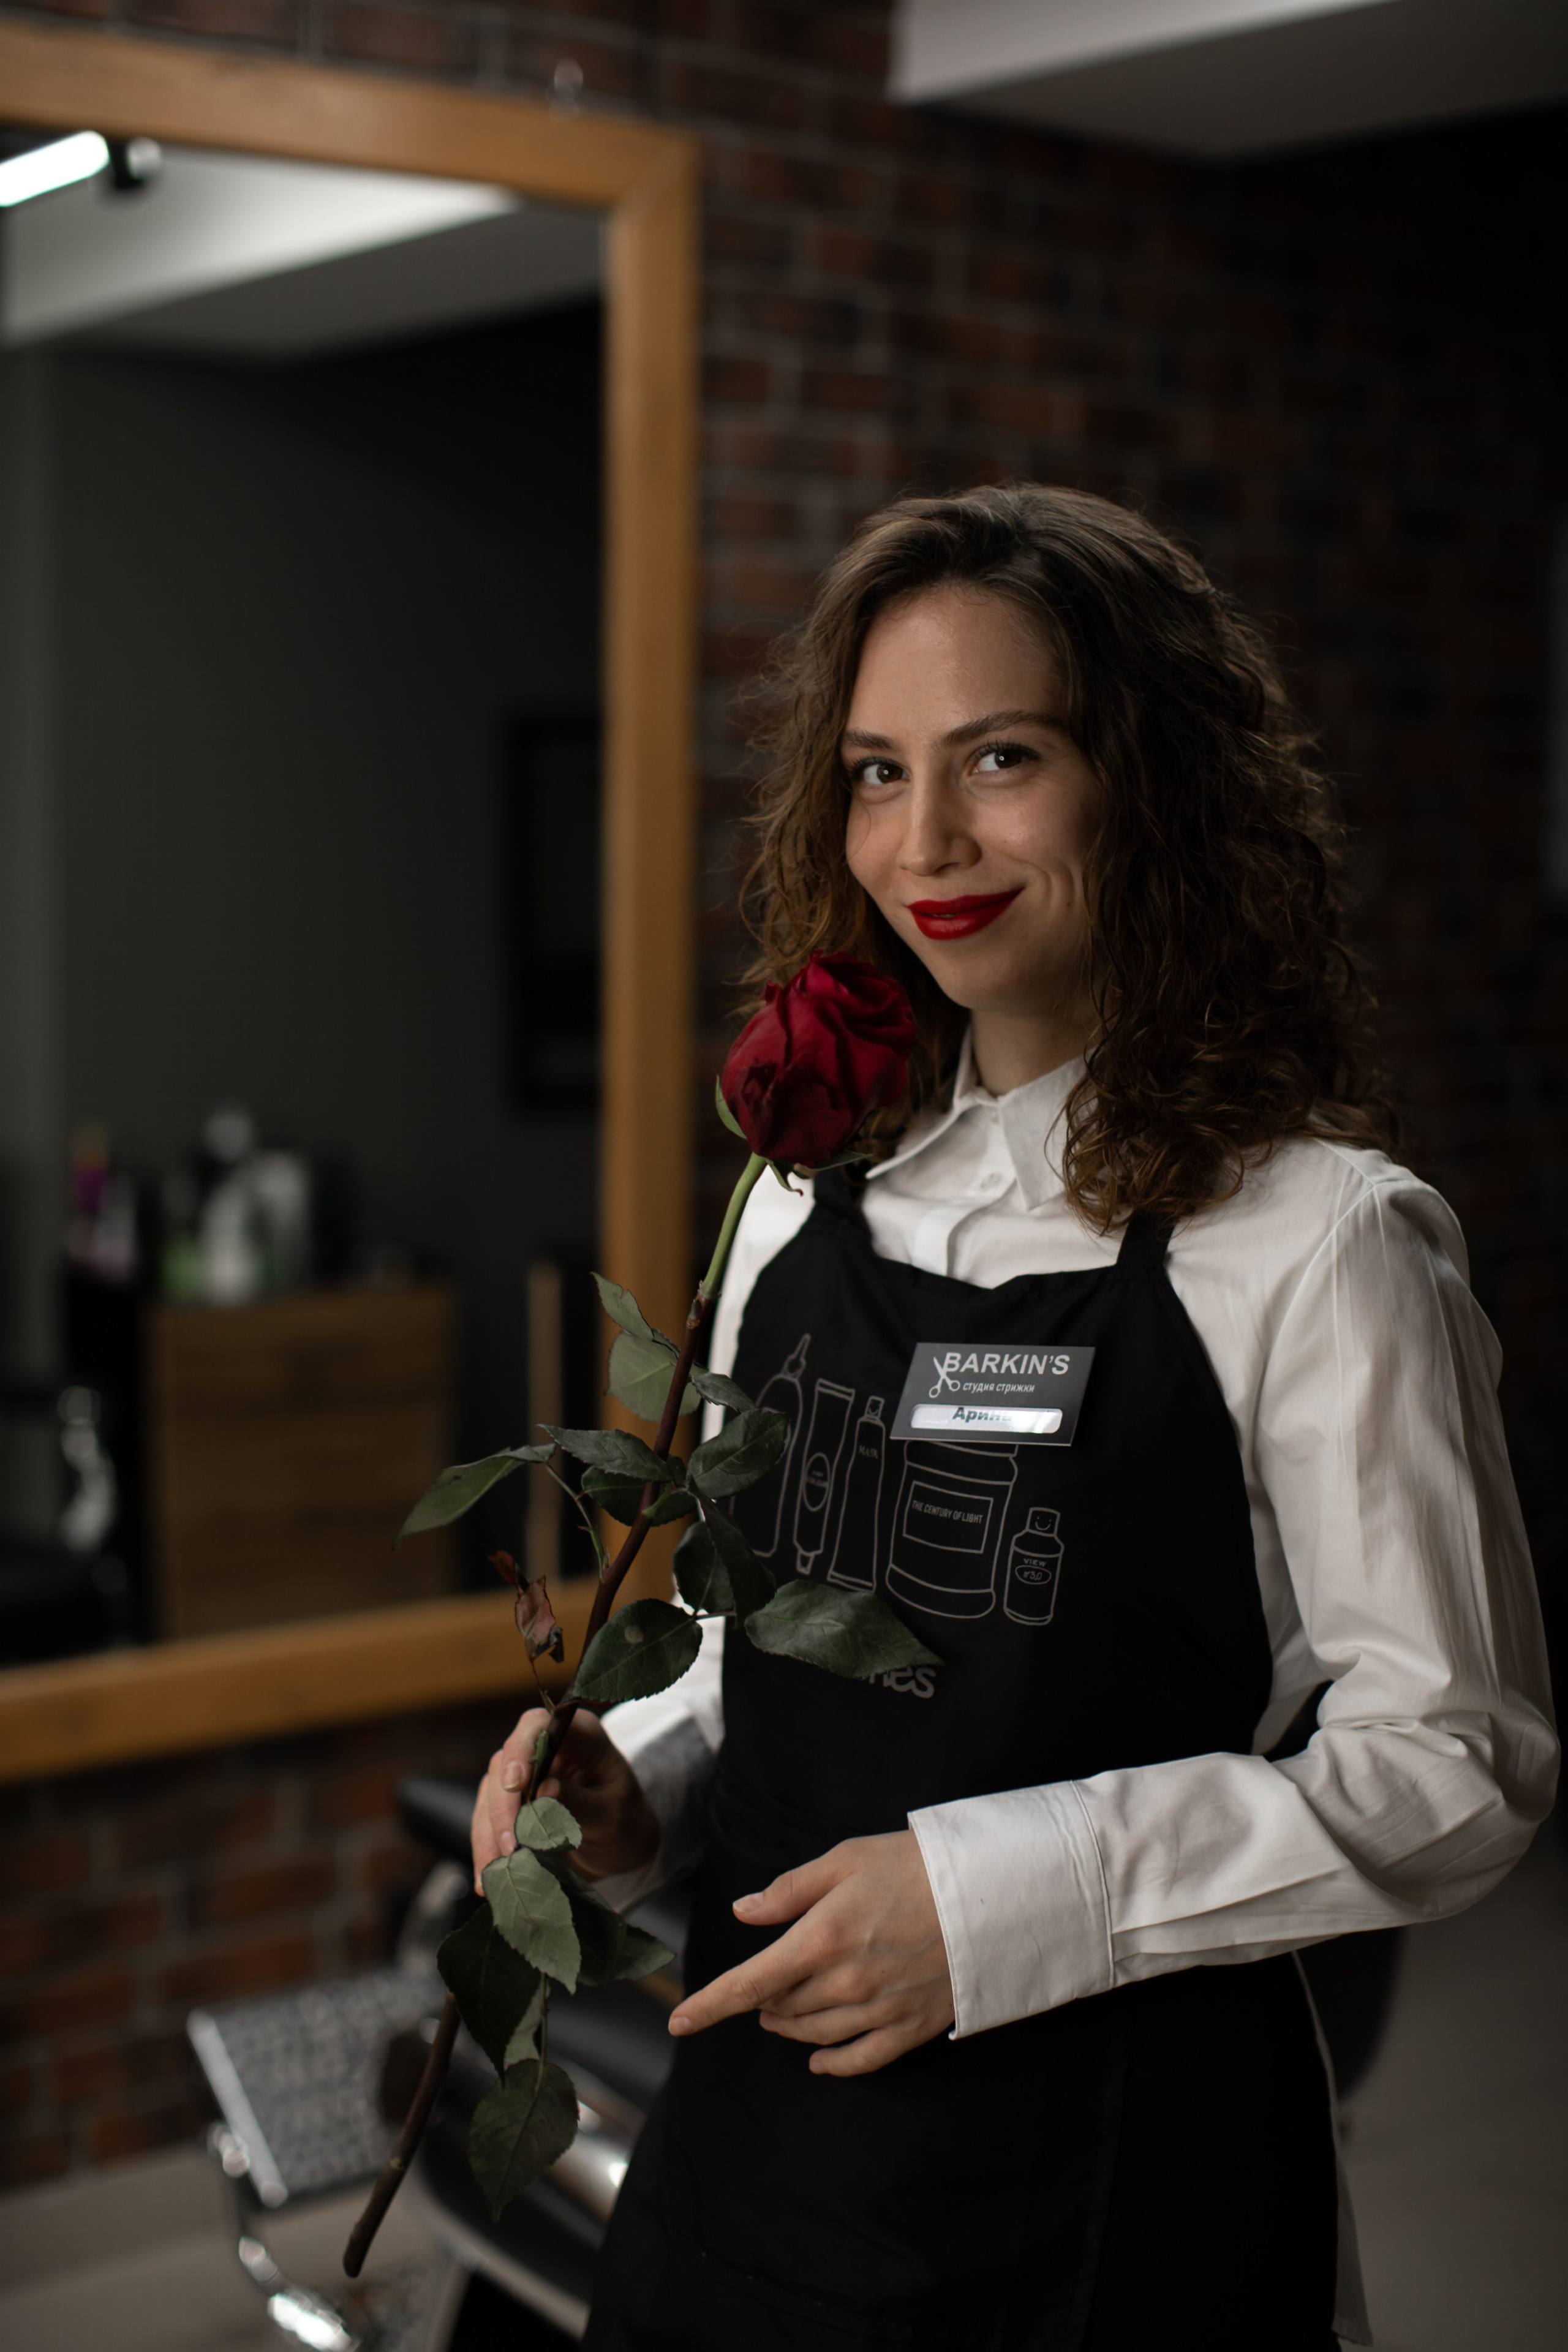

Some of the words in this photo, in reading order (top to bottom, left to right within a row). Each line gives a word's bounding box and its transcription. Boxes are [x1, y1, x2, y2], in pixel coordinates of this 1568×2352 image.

[944, 1352, 1070, 1375] BARKIN'S
[963, 1382, 994, 1392] студия
[996, 1382, 1035, 1395] стрижки
[911, 1500, 924, 1512] THE
[924, 1504, 953, 1518] CENTURY
[952, 1510, 963, 1521] OF
[962, 1512, 984, 1524] LIGHT
[1023, 1558, 1047, 1567] VIEW
